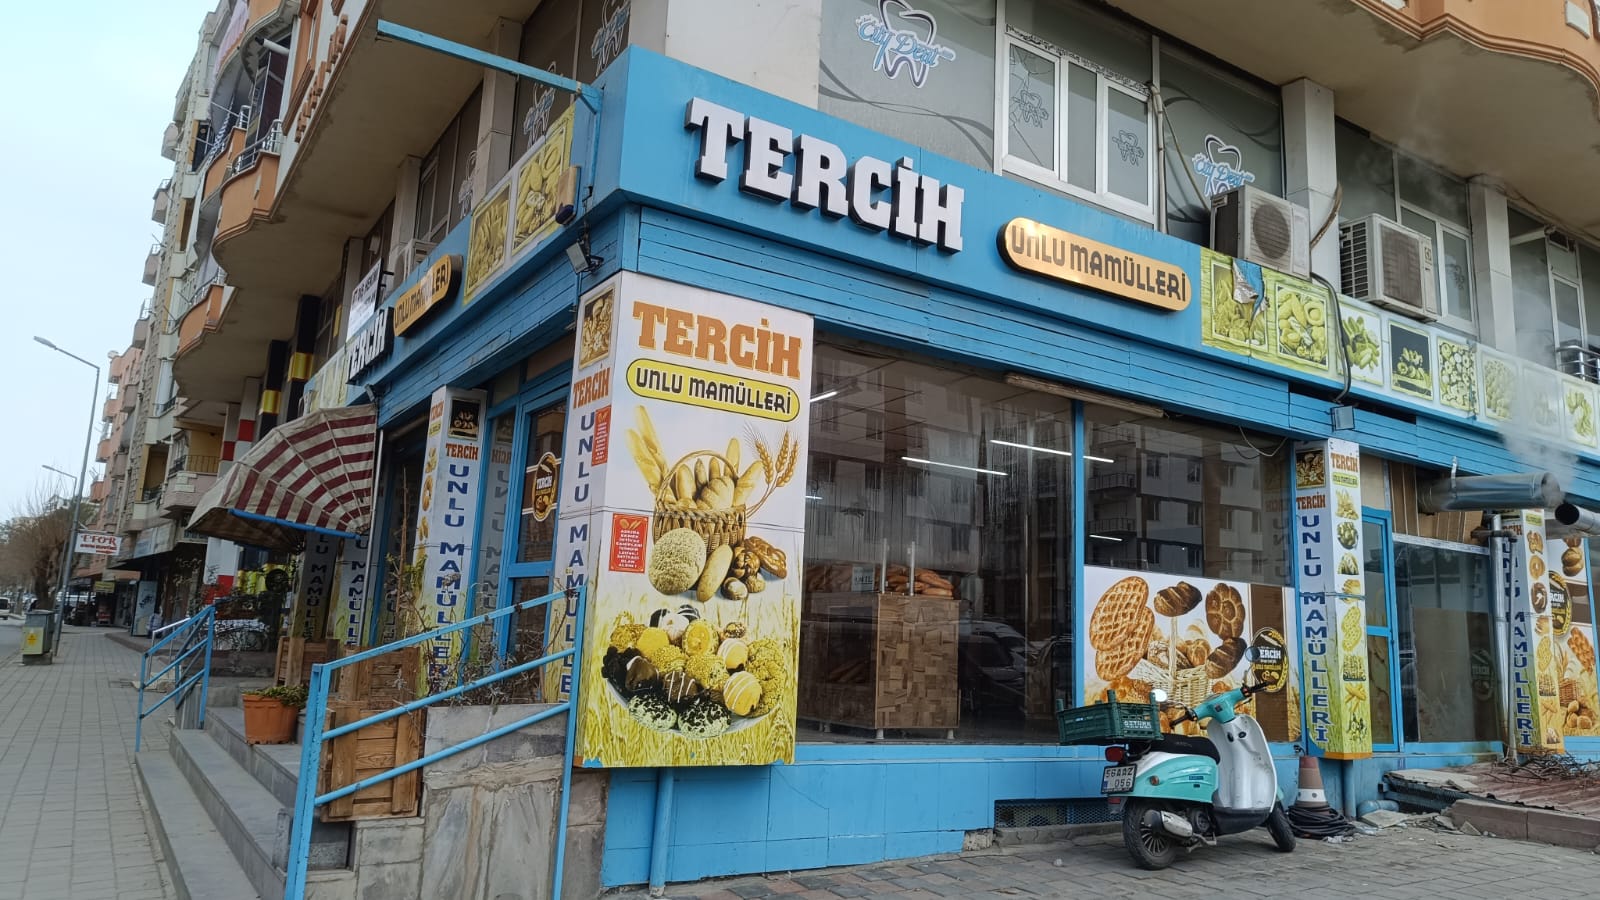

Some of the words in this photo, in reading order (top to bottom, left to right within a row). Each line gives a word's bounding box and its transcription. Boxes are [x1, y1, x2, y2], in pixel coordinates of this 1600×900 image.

[684, 97, 965, 255] TERCİH
[1011, 224, 1066, 269] UNLU
[1069, 246, 1187, 302] MAMÜLLERİ
[632, 301, 803, 380] TERCİH
[573, 363, 611, 409] TERCİH
[636, 367, 683, 394] UNLU
[688, 376, 791, 414] MAMÜLLERİ
[445, 442, 479, 461] TERCİH
[574, 411, 596, 502] UNLU
[1330, 451, 1359, 473] TERCİH
[444, 464, 470, 527] UNLU
[1296, 491, 1326, 510] TERCİH
[1302, 514, 1322, 577] UNLU
[1259, 648, 1281, 659] ERCİH
[1303, 592, 1331, 742] MAMÜLLERİ
[1115, 778, 1131, 788] 056
